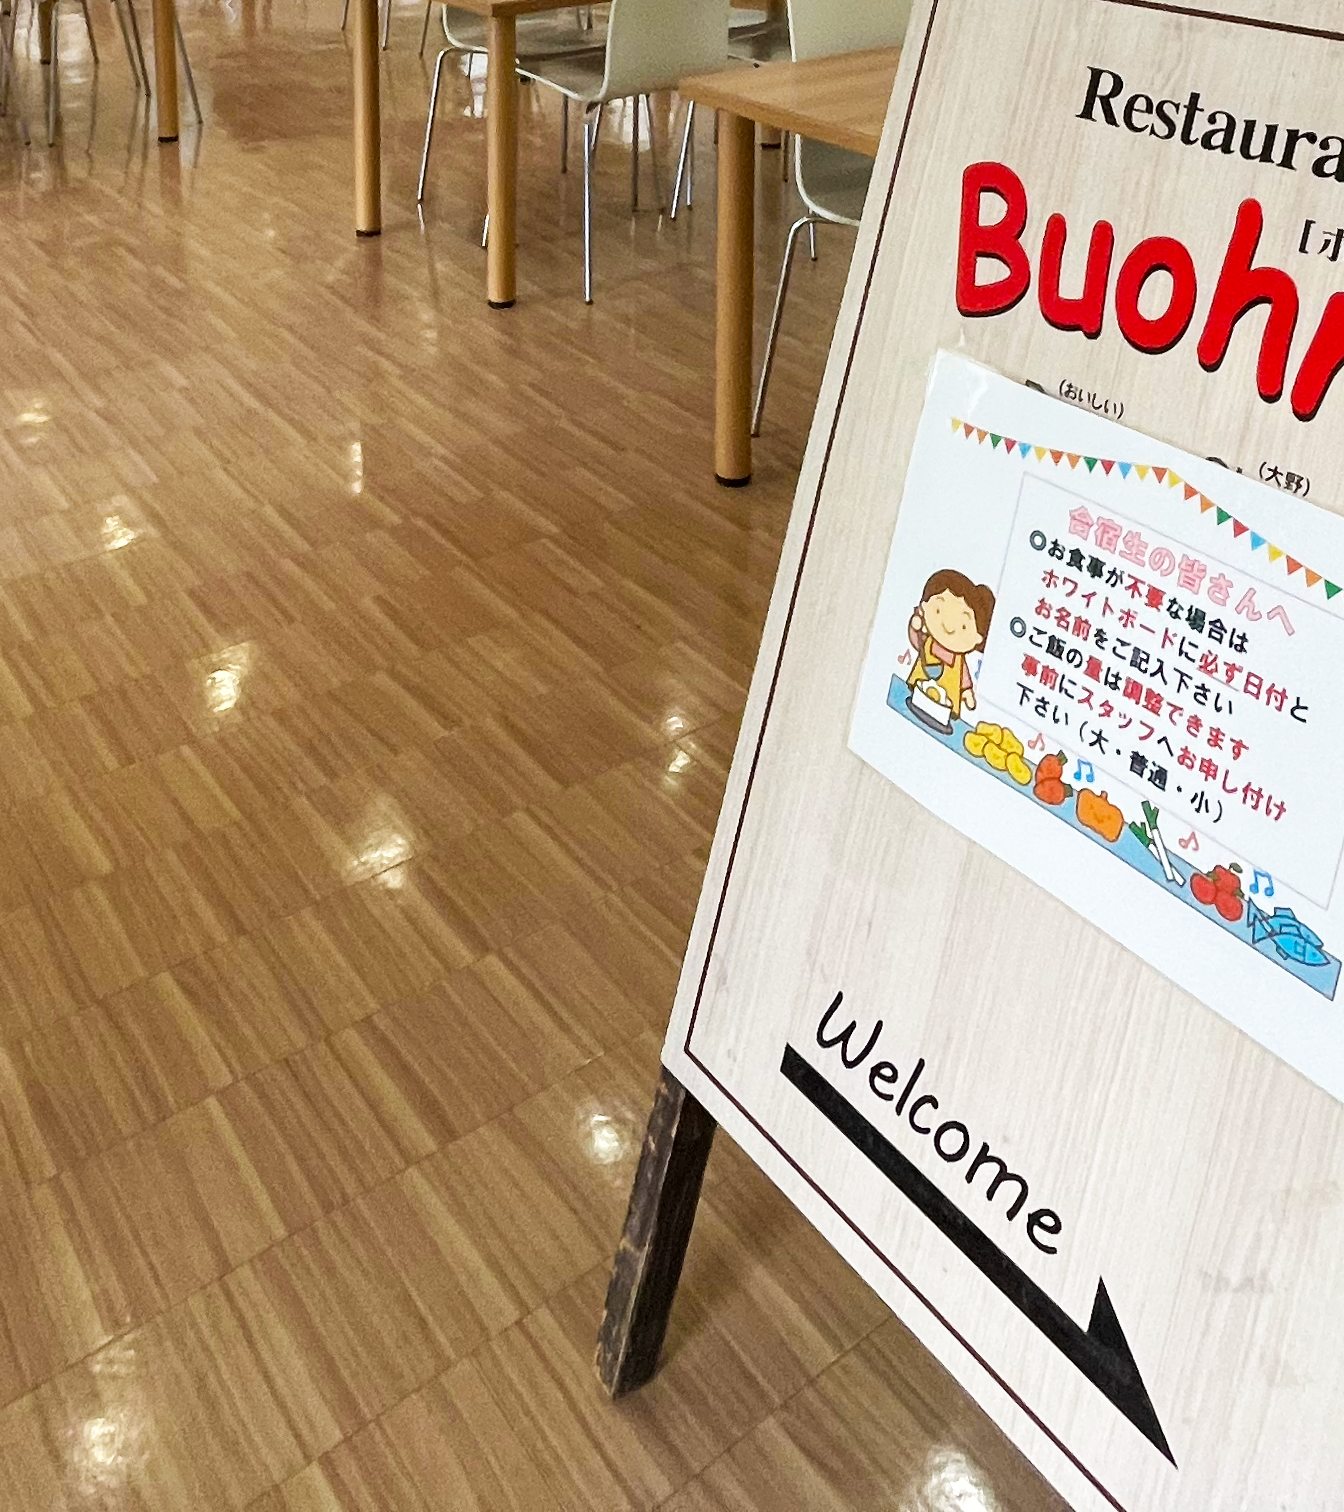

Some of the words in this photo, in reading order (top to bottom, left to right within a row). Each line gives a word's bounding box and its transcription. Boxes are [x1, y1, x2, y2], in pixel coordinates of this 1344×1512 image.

[1058, 378, 1125, 419] (おいしい)
[1258, 461, 1311, 497] (大野)
[1068, 505, 1296, 636] 合宿生の皆さんへ
[1034, 597, 1233, 715] お名前をご記入下さい
[1041, 569, 1309, 723] ホワイトボードに必ず日付と
[1021, 653, 1287, 822] 事前にスタッフへお申し付け
[816, 991, 1062, 1255] Welcome
